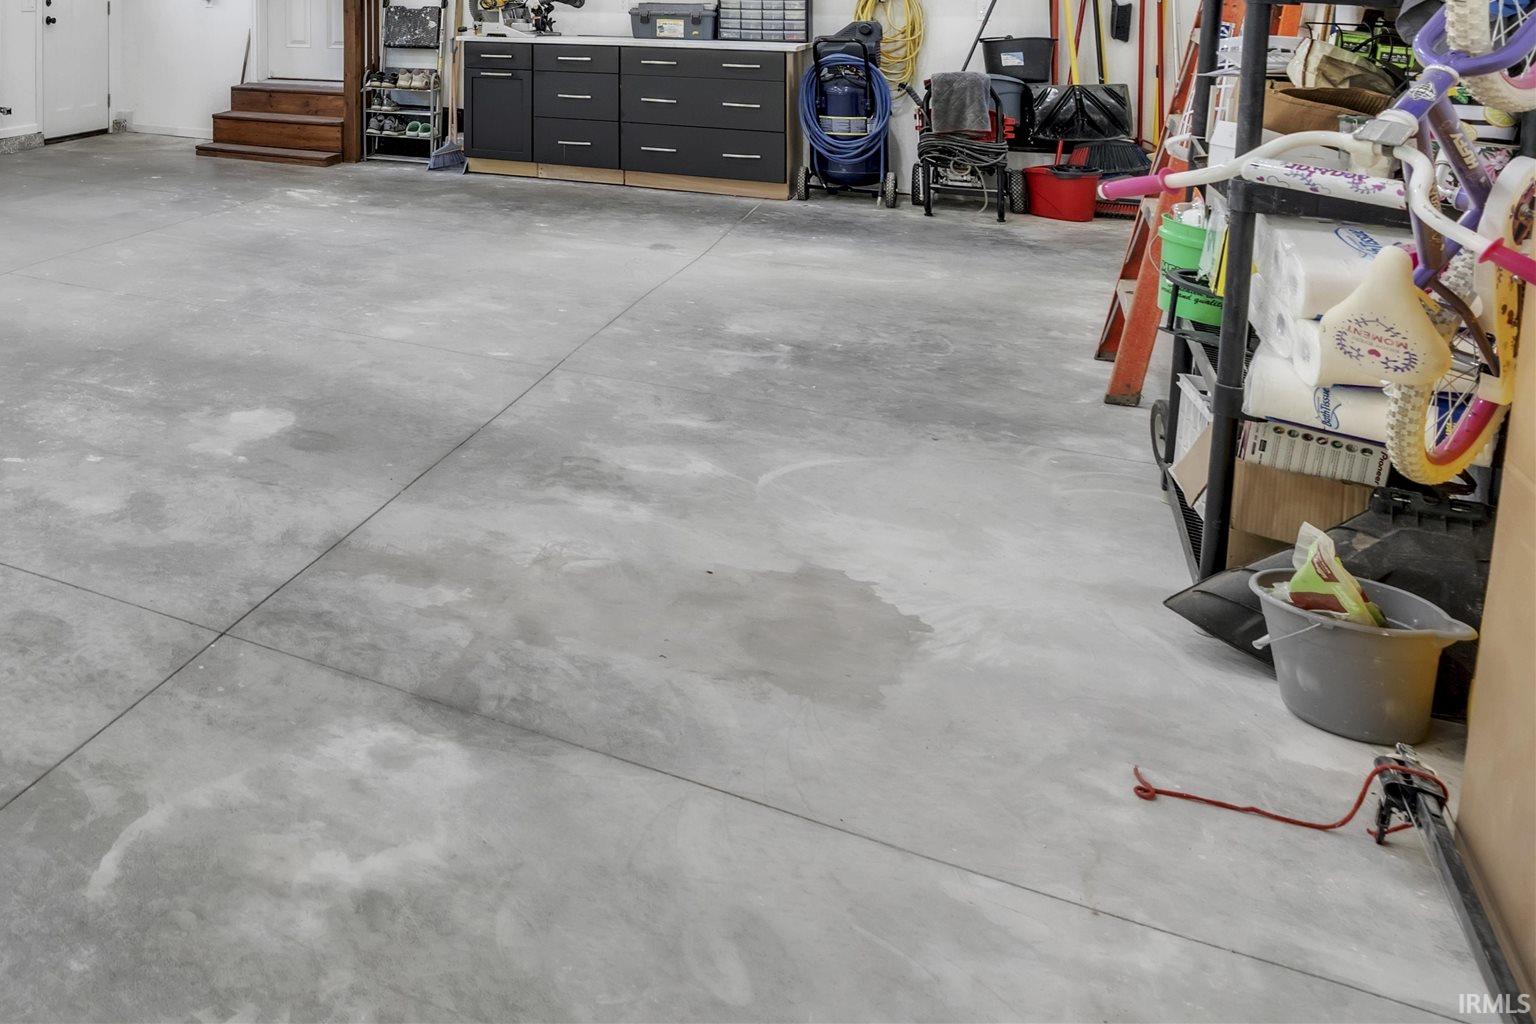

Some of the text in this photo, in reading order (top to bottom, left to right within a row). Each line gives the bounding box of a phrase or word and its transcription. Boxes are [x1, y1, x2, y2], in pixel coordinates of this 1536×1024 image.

[1448, 132, 1479, 170] HUFFY
[1346, 325, 1409, 350] MOMENT
[1375, 450, 1389, 485] Pioneer
